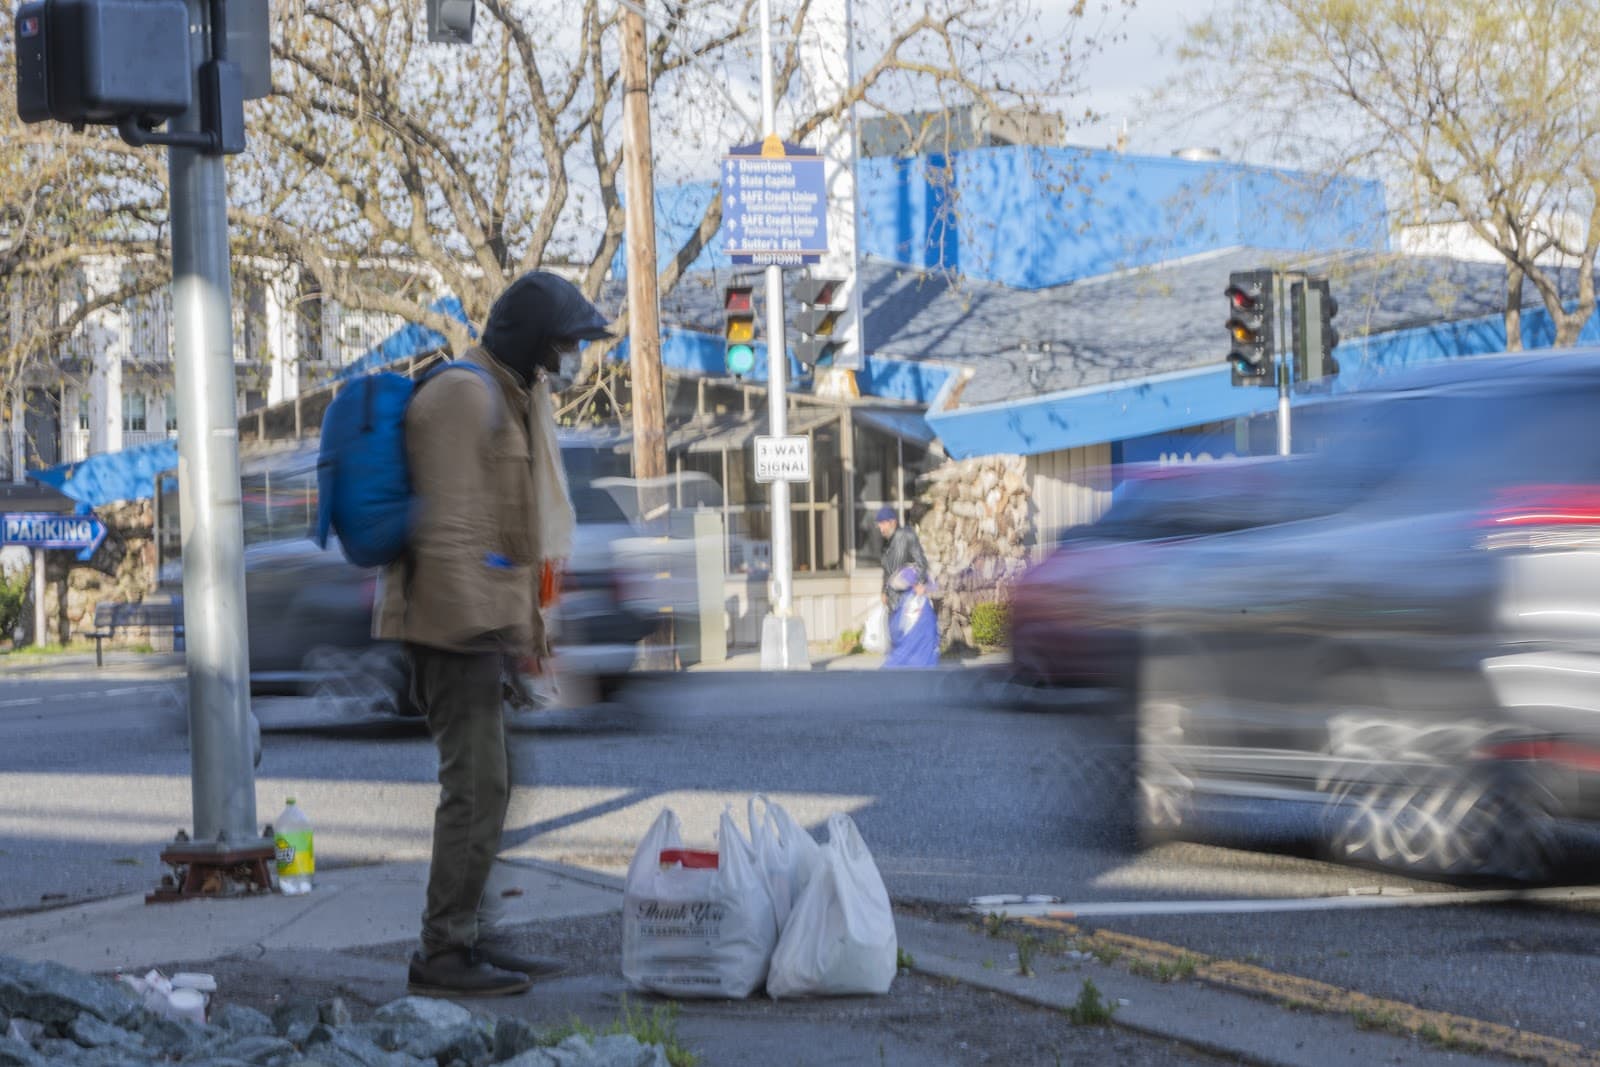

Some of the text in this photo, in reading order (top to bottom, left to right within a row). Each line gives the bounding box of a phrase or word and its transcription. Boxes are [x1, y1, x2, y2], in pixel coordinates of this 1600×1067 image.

[739, 160, 792, 172] Downtown
[740, 174, 763, 188] State
[740, 190, 818, 204] SAFE Credit Union
[741, 214, 819, 228] SAFE Credit Union
[742, 238, 802, 250] Sutter's Fort
[752, 253, 803, 265] MIDTOWN
[760, 462, 806, 473] SIGNAL
[7, 519, 92, 541] PARKING
[636, 901, 724, 926] Thank You
